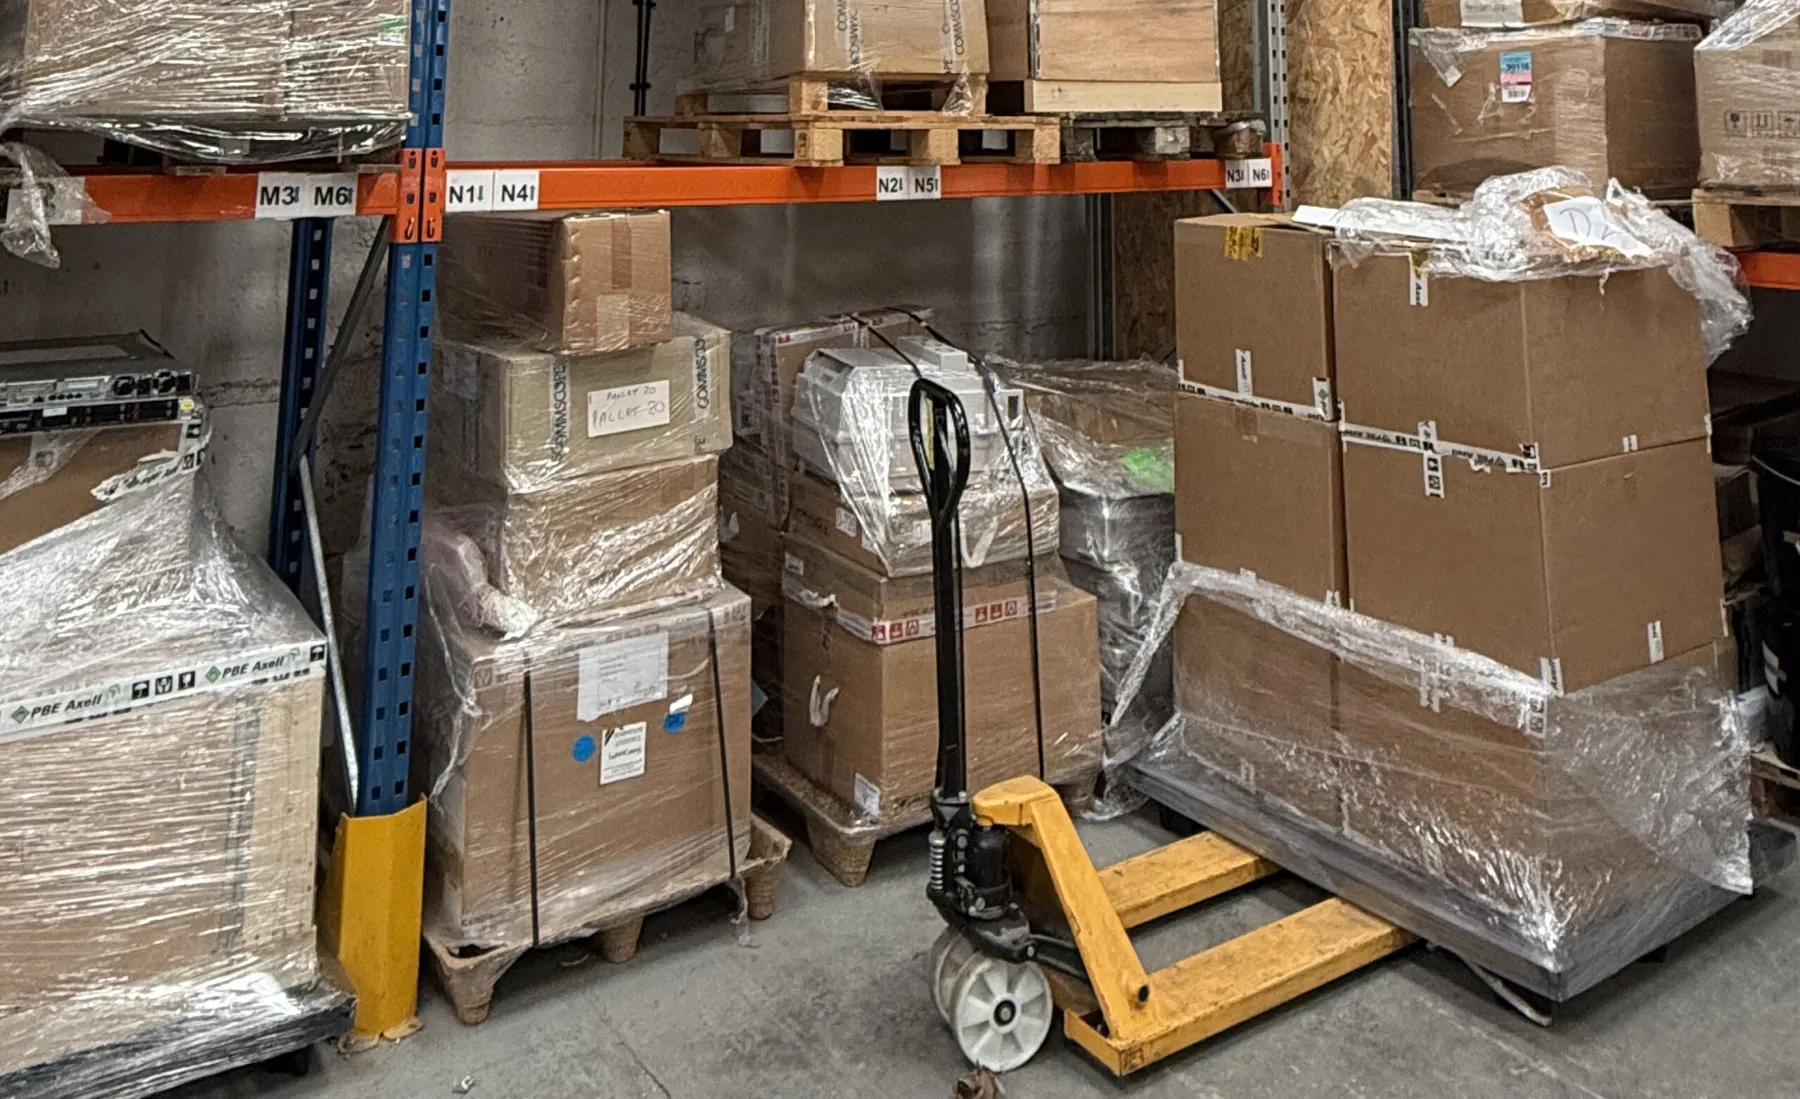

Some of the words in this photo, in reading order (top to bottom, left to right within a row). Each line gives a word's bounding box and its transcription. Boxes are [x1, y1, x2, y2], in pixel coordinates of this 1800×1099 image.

[1226, 168, 1241, 182] N3
[1252, 168, 1267, 181] N6
[449, 185, 475, 203] N1
[501, 184, 529, 202] N4
[878, 177, 898, 193] N2
[914, 177, 934, 193] N5
[259, 186, 294, 206] M3
[314, 186, 349, 205] M6
[643, 385, 657, 395] 20
[222, 663, 250, 679] PBE
[252, 656, 285, 672] Axell
[30, 702, 62, 719] PBE
[64, 693, 103, 712] Axell
